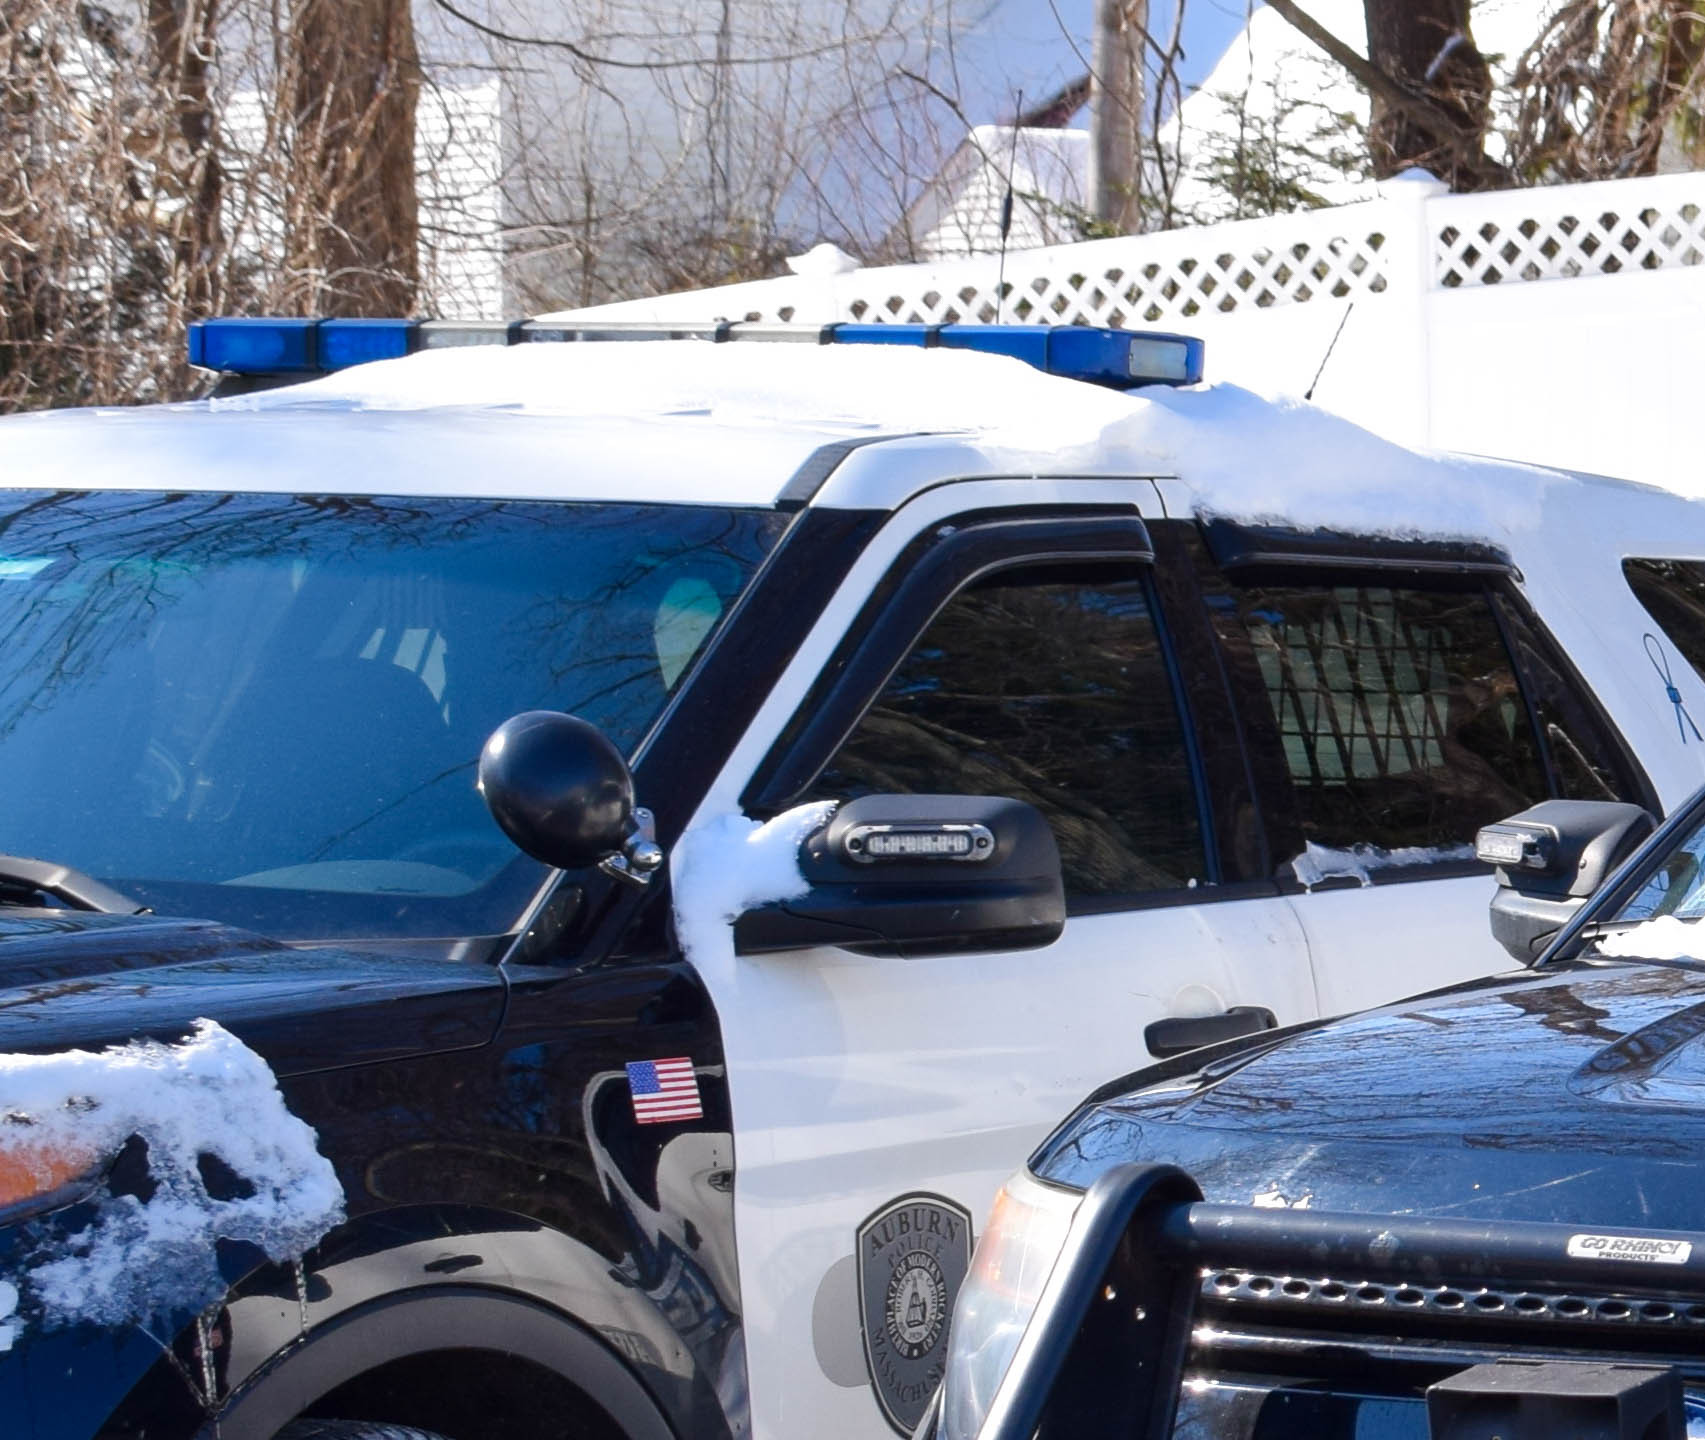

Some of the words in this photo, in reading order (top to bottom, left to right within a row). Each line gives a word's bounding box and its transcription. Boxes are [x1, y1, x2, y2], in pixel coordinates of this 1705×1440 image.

[870, 1208, 960, 1258] AUBURN
[1580, 1237, 1609, 1250] GO
[888, 1234, 943, 1269] POLICE
